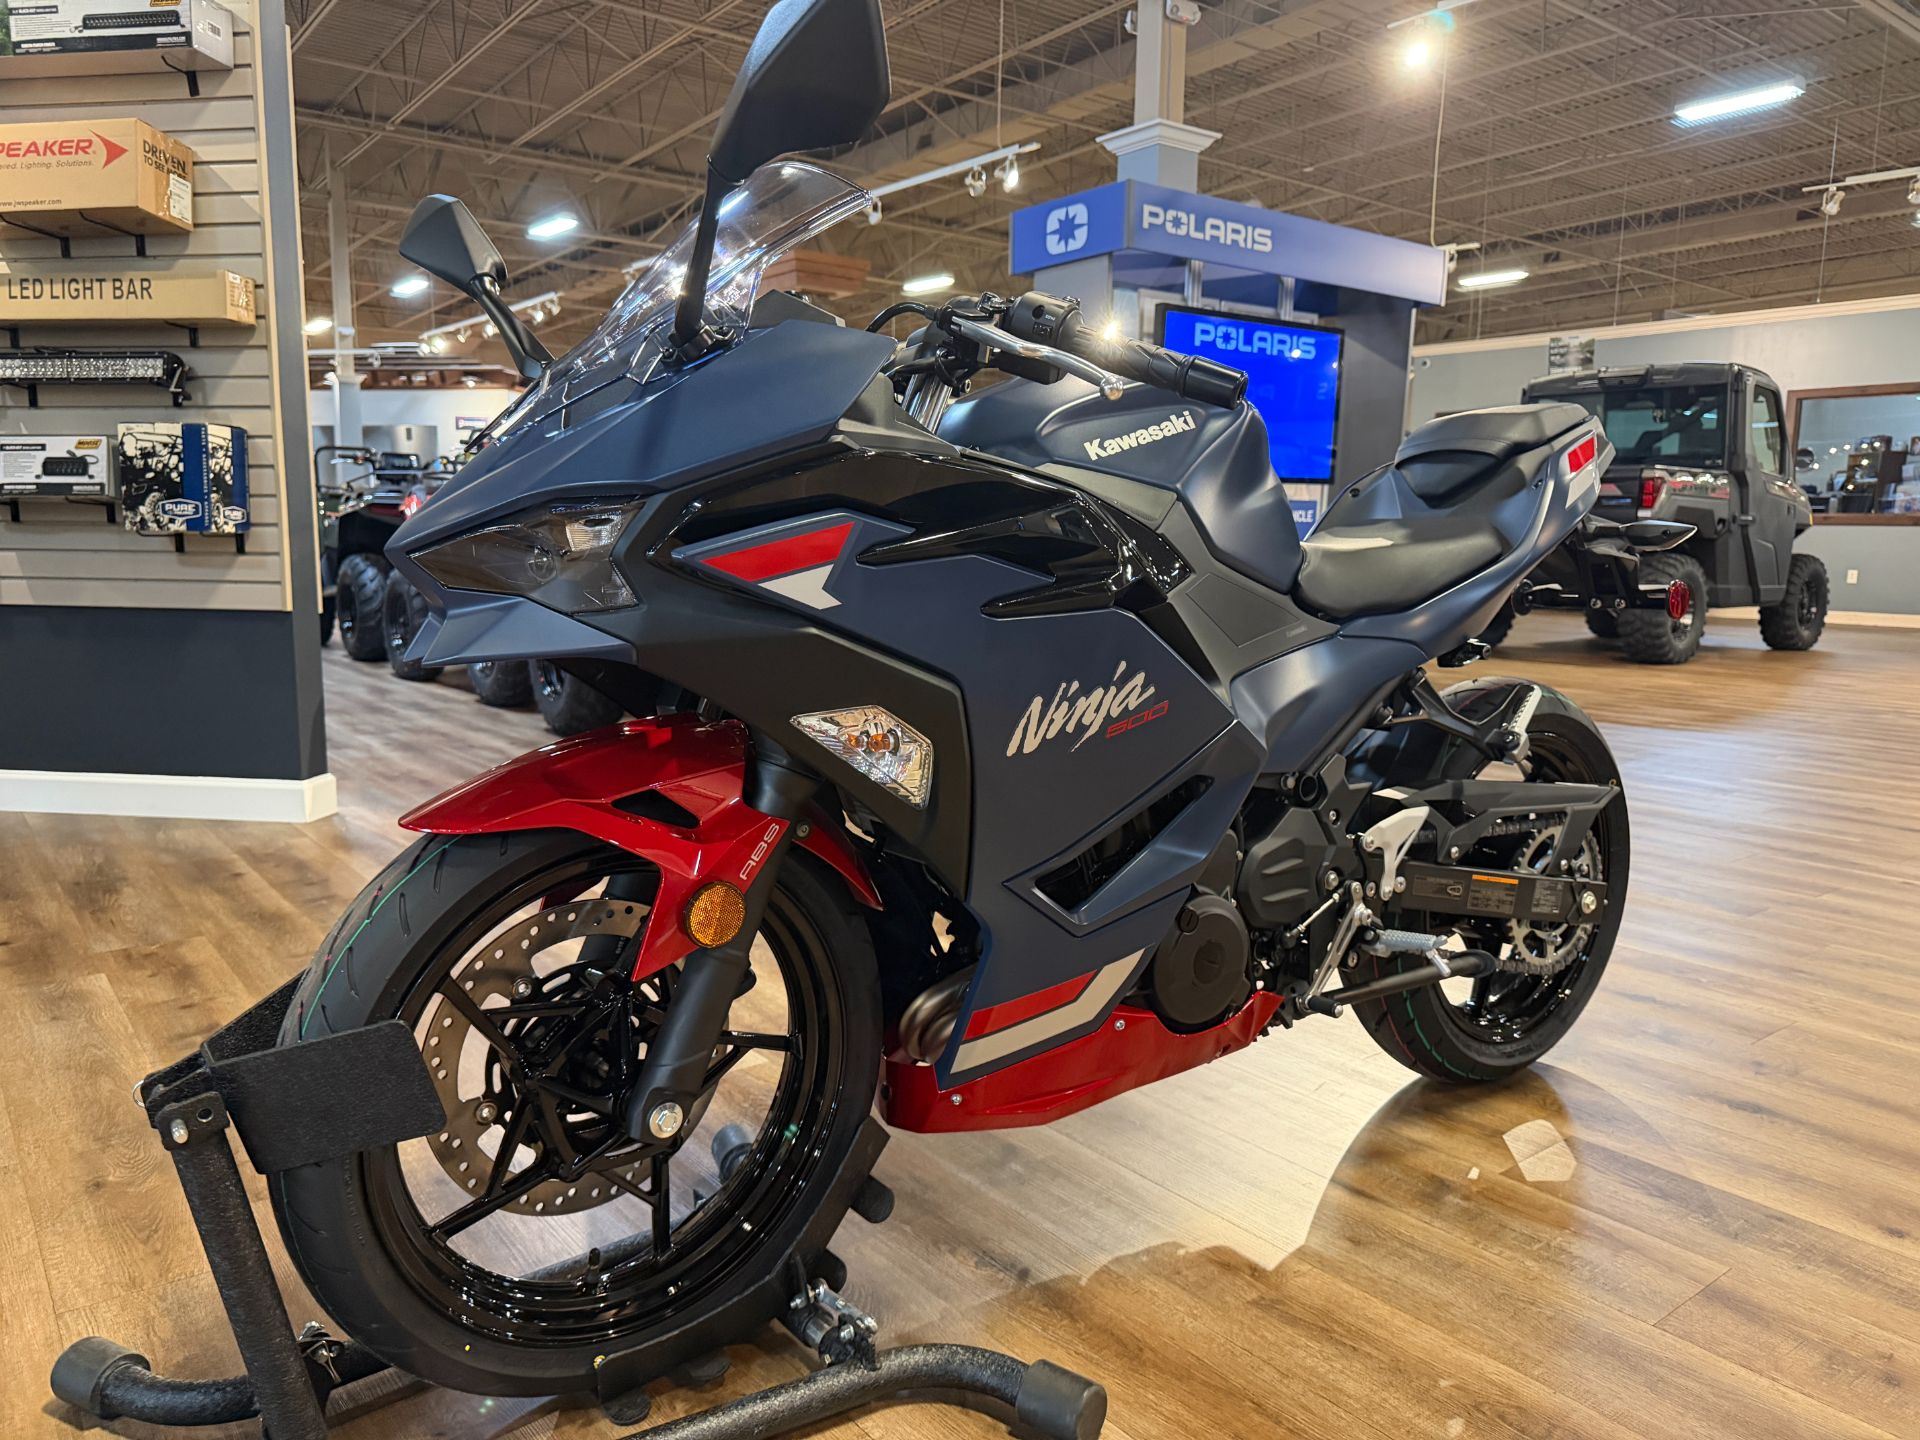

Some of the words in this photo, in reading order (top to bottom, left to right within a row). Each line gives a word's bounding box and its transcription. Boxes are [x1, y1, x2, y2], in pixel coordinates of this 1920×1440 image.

[56, 159, 94, 168] Solutions.
[143, 138, 187, 175] DRIVEN
[143, 154, 154, 167] TO
[154, 160, 166, 174] SEE
[1142, 204, 1273, 253] POLARIS
[8, 278, 44, 299] LED
[50, 278, 106, 299] LIGHT
[112, 278, 153, 299] BAR
[1194, 322, 1317, 360] POLARIS
[1083, 410, 1196, 461] Kawasaki
[165, 503, 196, 512] PURE
[1006, 660, 1156, 757] Ninja
[1105, 699, 1169, 739] 500
[739, 822, 780, 880] ABS
